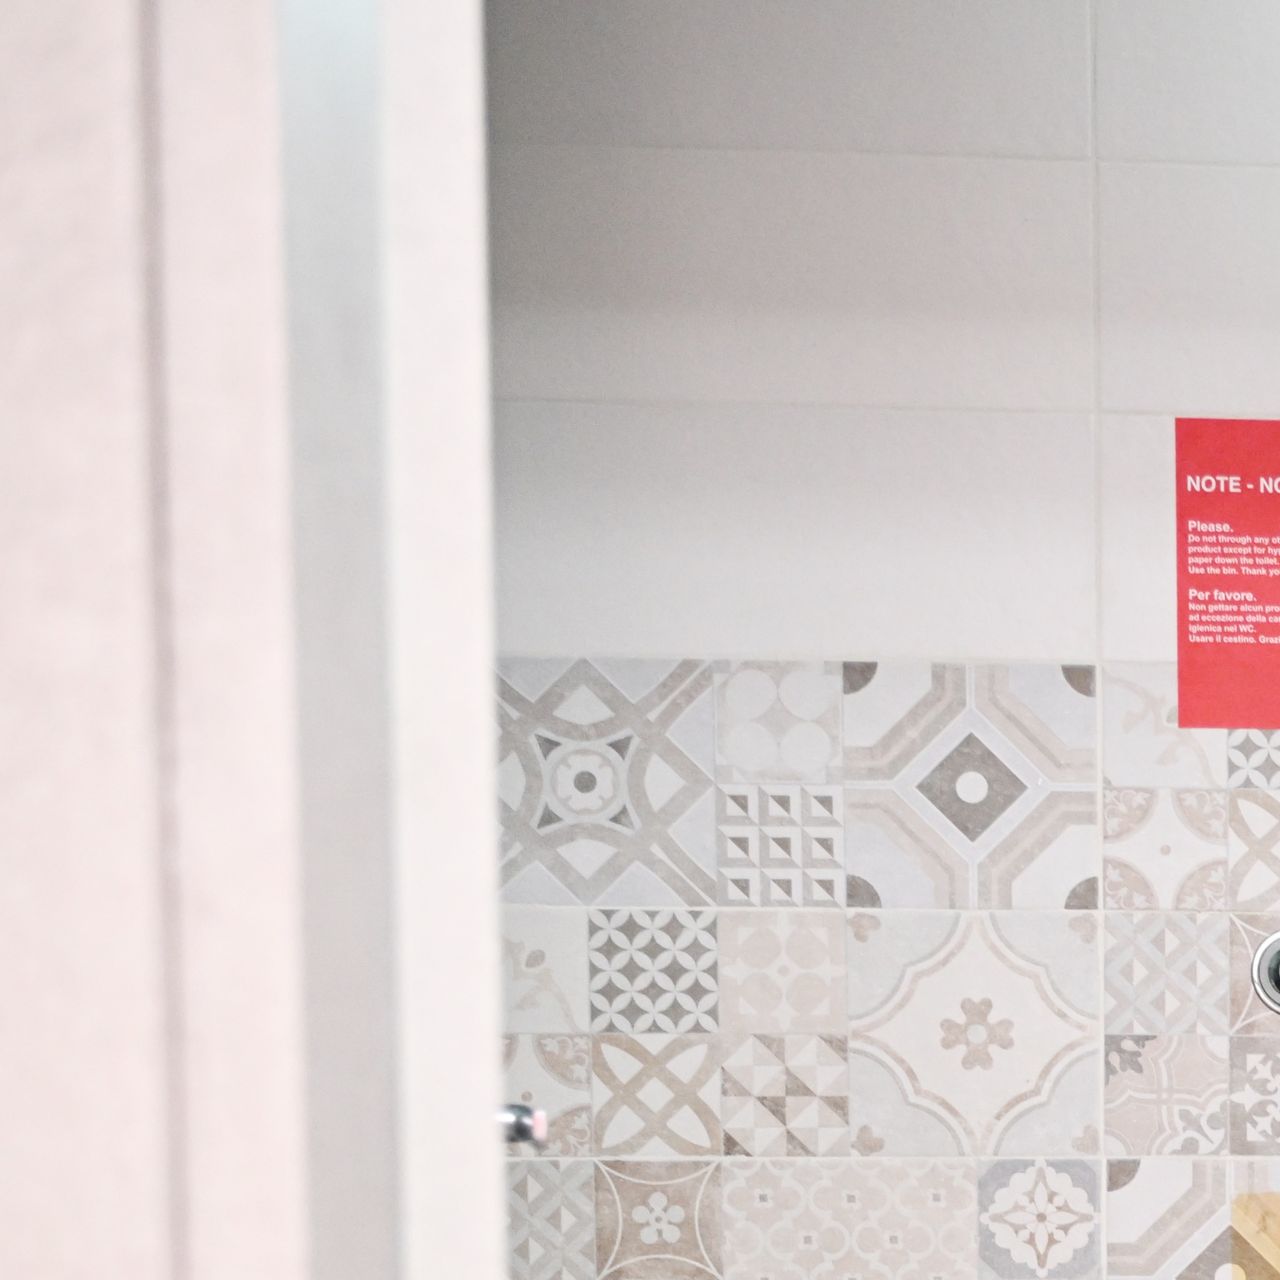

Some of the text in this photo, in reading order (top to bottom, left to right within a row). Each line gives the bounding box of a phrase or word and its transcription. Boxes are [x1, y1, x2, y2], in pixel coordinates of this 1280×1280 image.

[1186, 475, 1241, 493] NOTE
[1188, 520, 1234, 532] Please.
[1188, 534, 1200, 543] Do
[1202, 535, 1216, 543] not
[1218, 535, 1252, 545] through
[1254, 537, 1269, 545] any
[1188, 545, 1221, 554] product
[1223, 546, 1252, 555] except
[1188, 556, 1280, 565] paper down the toilet.
[1188, 566, 1205, 574] Use
[1206, 566, 1221, 574] the
[1222, 566, 1238, 574] bin.
[1241, 567, 1267, 575] Thank
[1189, 589, 1257, 601] Per favore.
[1188, 602, 1206, 611] Non
[1208, 603, 1238, 613] gettare
[1239, 604, 1263, 612] alcun
[1188, 614, 1199, 622] ad
[1224, 624, 1237, 632] nel
[1188, 635, 1214, 643] Usare
[1215, 635, 1221, 643] il
[1223, 635, 1256, 643] cestino.
